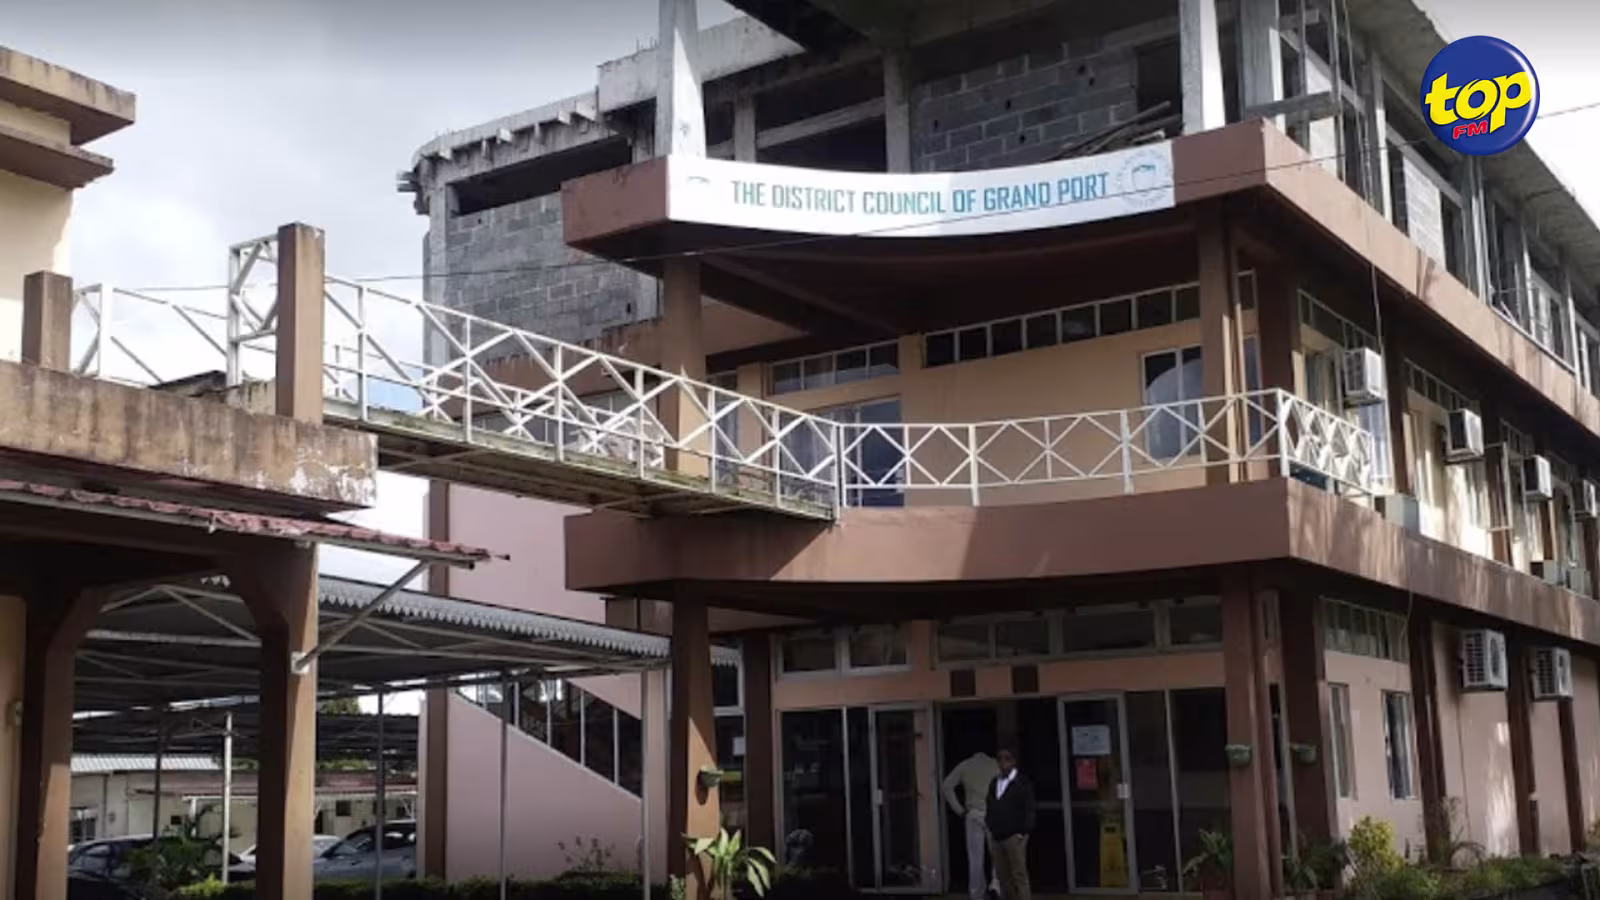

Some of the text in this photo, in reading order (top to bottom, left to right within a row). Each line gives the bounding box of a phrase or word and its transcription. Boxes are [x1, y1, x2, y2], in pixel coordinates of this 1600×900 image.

[731, 180, 767, 207] THE
[771, 184, 855, 213] DISTRICT
[862, 189, 946, 216] COUNCIL
[952, 188, 977, 214] OF
[983, 181, 1051, 212] GRAND
[1056, 171, 1109, 206] PORT
